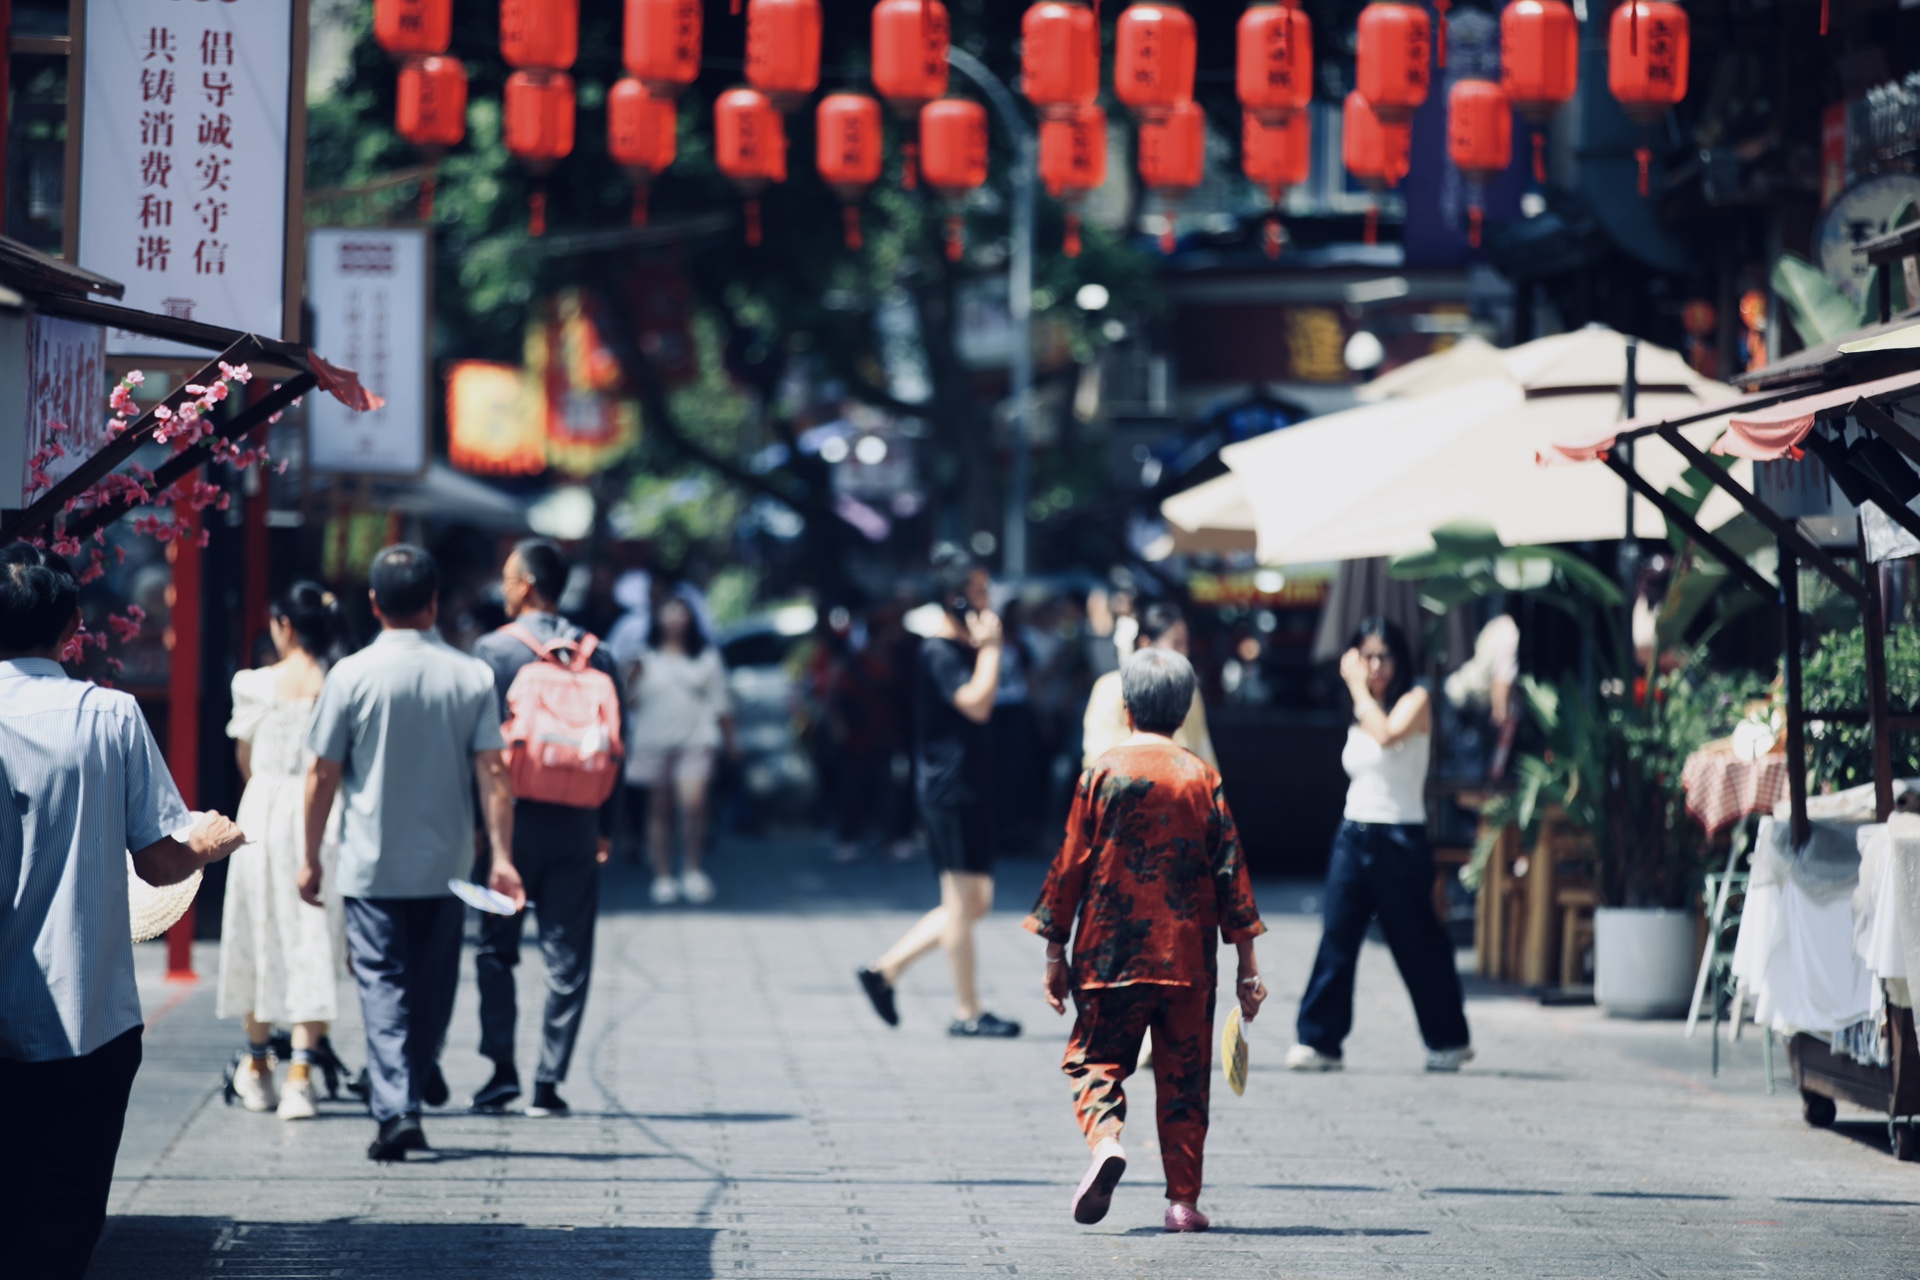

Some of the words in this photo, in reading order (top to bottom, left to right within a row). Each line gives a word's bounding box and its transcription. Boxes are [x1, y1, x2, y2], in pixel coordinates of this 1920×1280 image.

[136, 27, 176, 273] 共铸消费和谐
[193, 29, 234, 275] 倡导诚实守信
